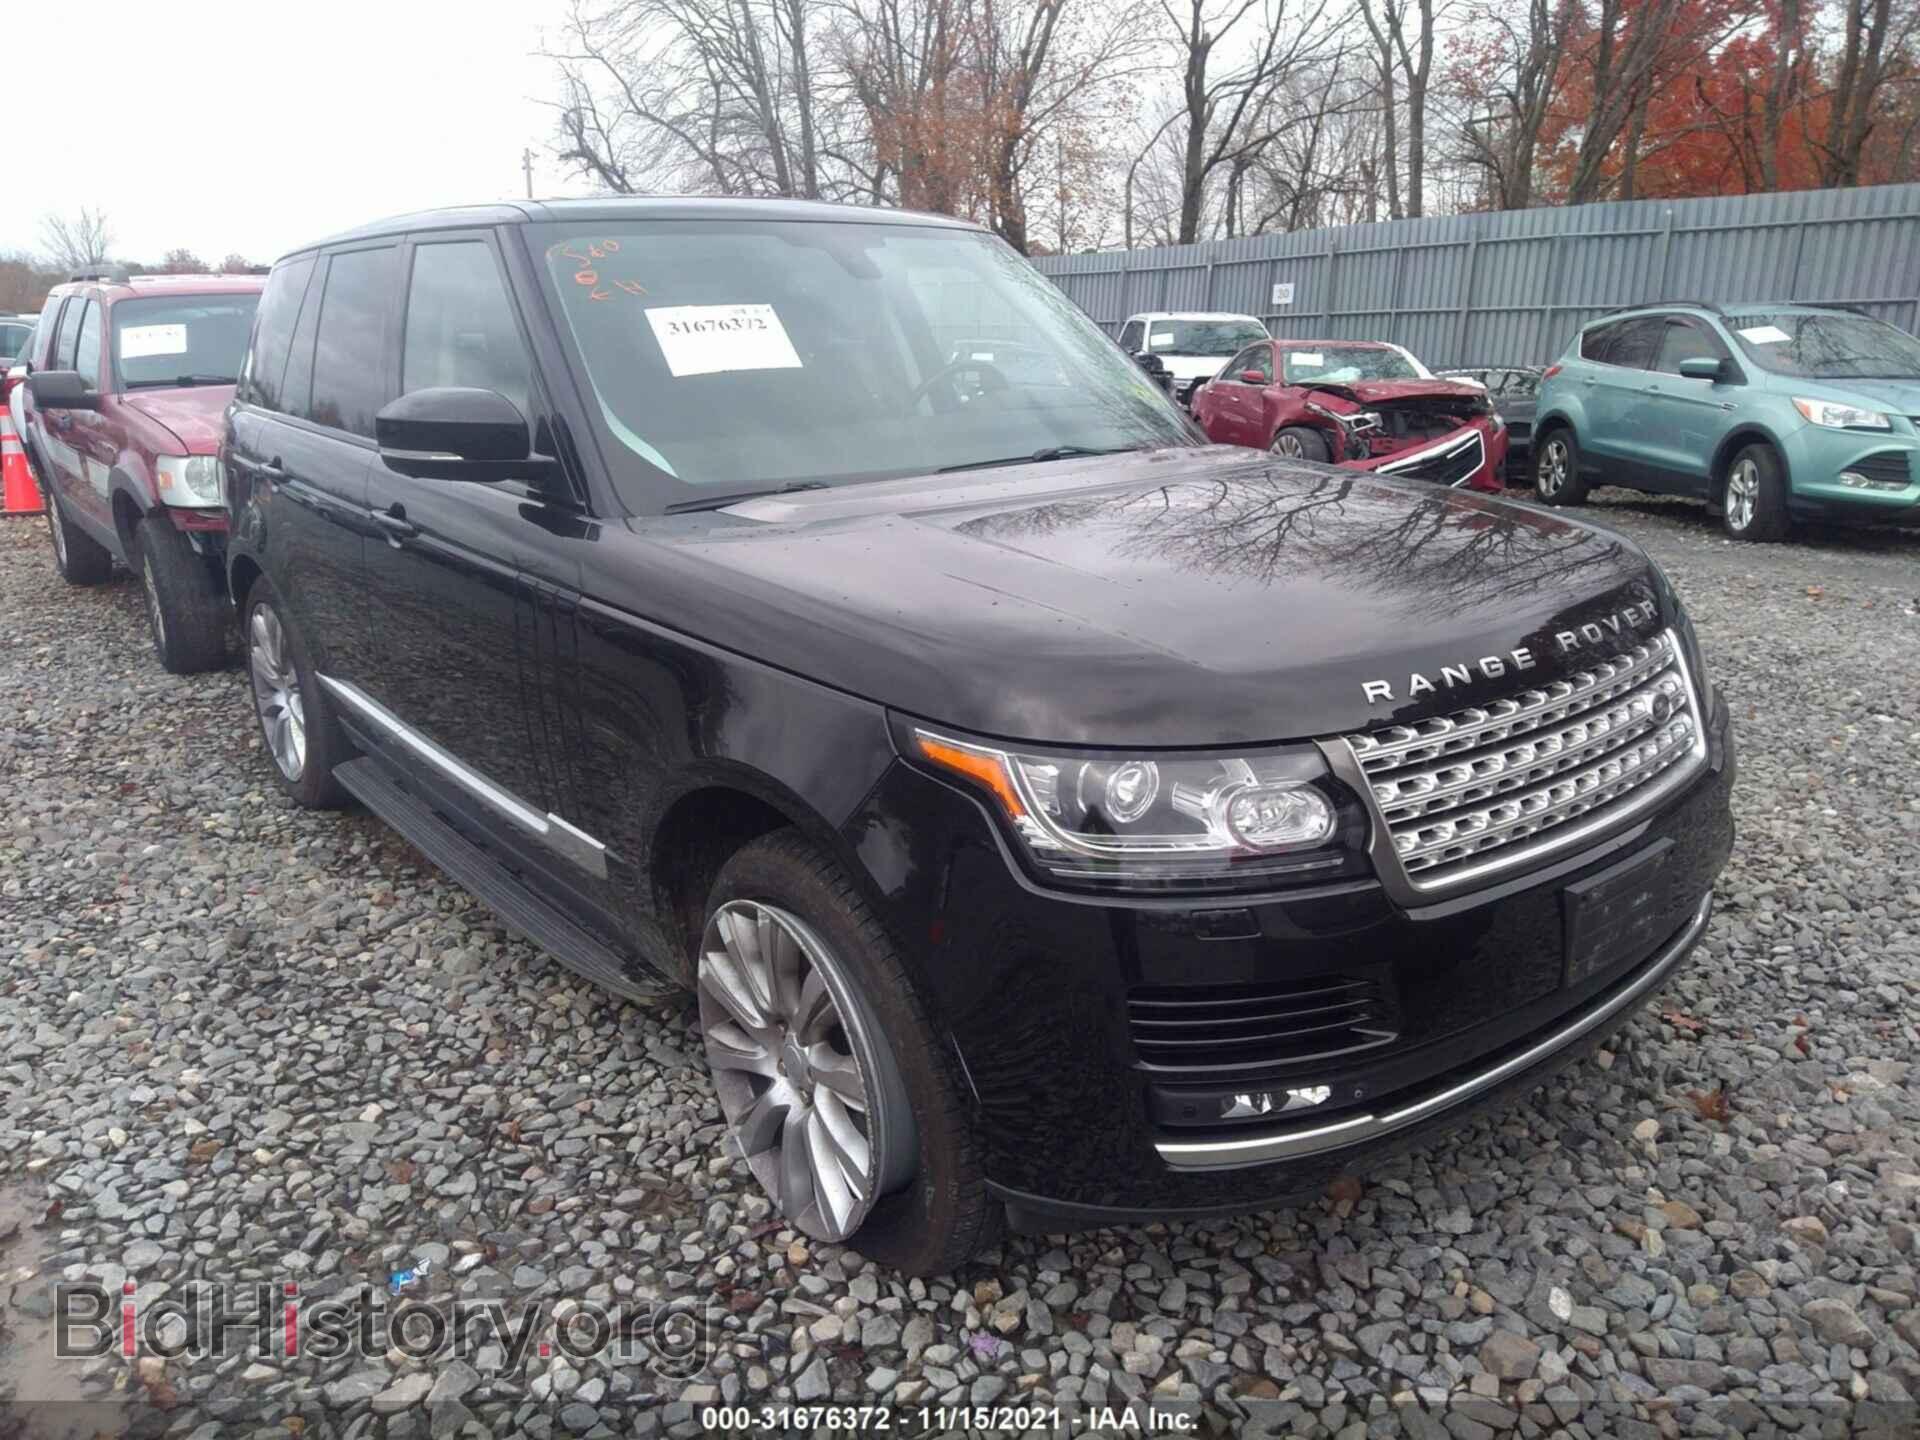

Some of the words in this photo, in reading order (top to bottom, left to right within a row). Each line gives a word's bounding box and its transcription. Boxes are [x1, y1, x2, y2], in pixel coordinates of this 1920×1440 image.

[668, 317, 768, 335] 31676372
[1362, 647, 1537, 704] RANGE
[1555, 601, 1658, 652] ROVER
